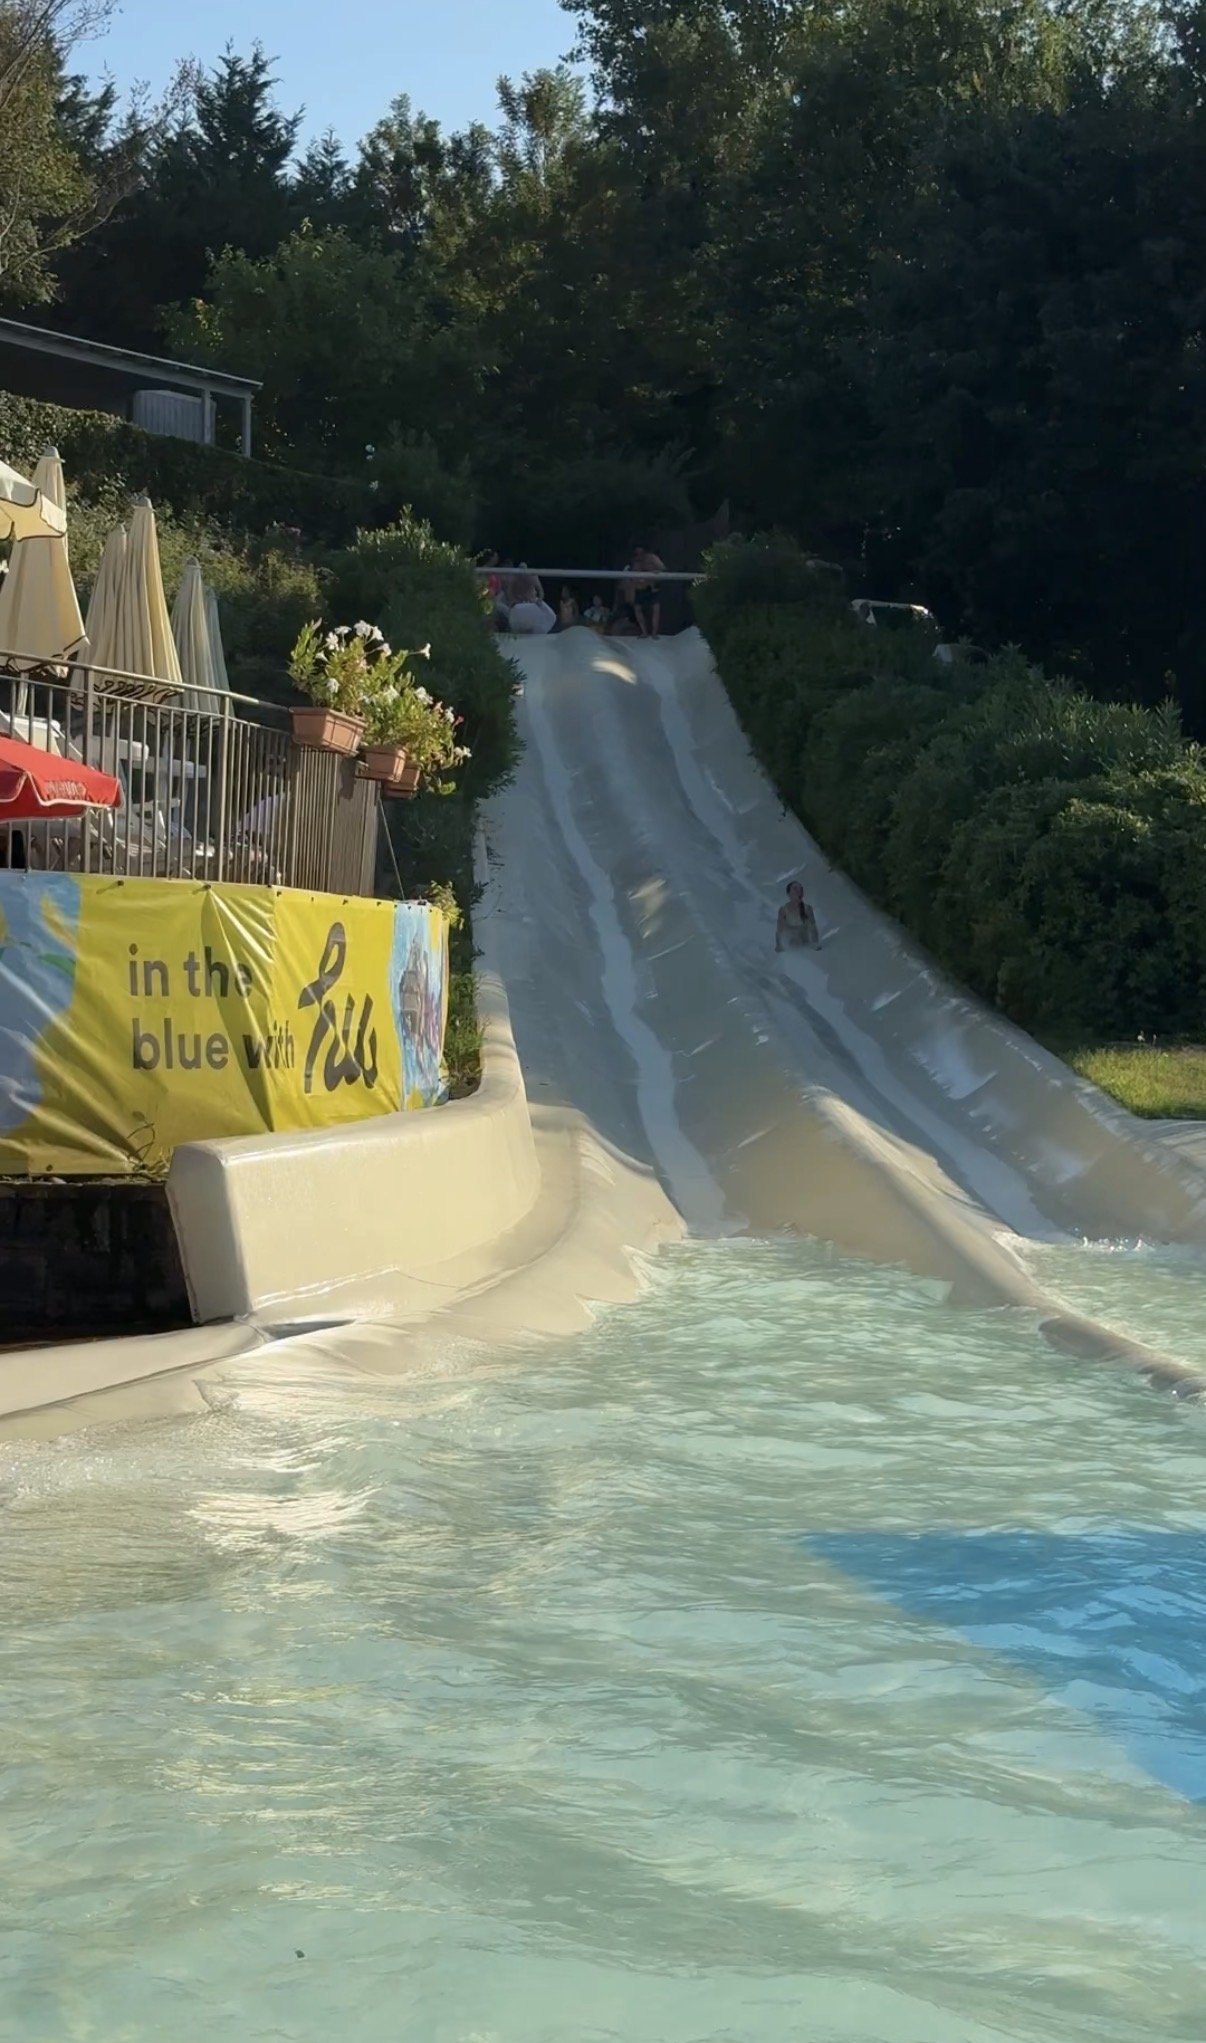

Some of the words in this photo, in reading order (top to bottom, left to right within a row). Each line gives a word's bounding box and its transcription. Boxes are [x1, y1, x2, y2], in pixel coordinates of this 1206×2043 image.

[128, 943, 170, 997] in
[183, 946, 254, 998] the
[132, 1017, 229, 1071] blue
[242, 1019, 295, 1070] with
